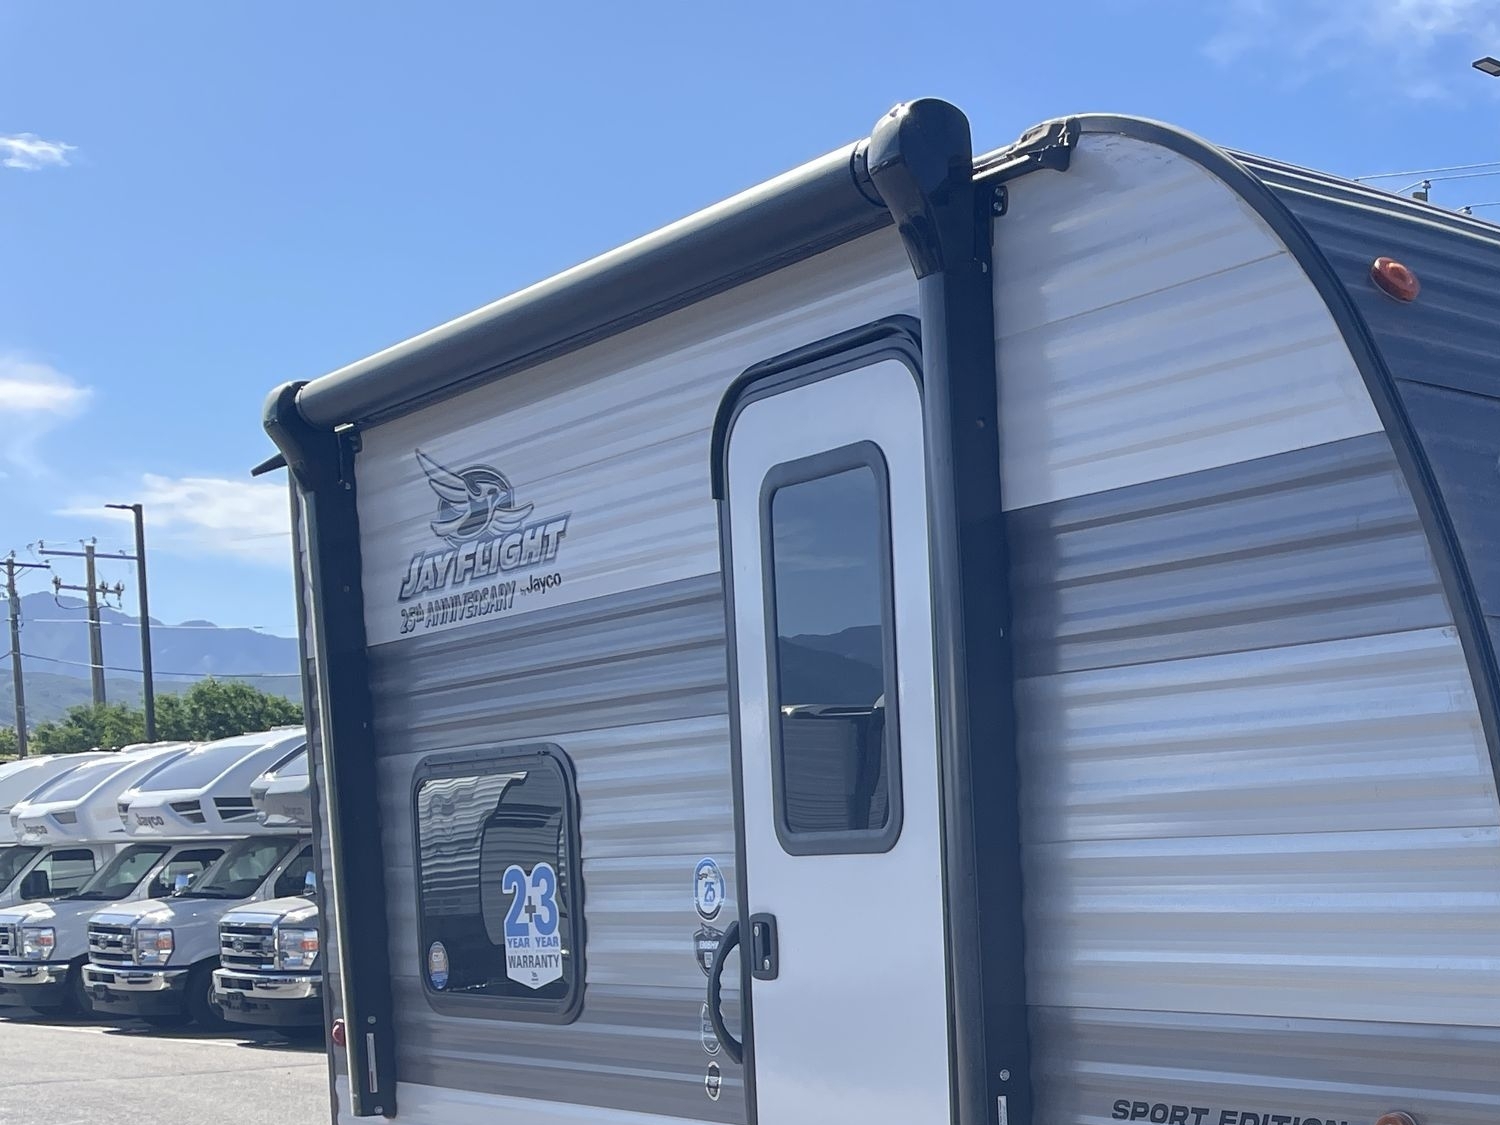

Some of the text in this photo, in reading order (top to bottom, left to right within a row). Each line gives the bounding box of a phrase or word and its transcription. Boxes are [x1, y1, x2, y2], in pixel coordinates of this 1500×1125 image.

[425, 580, 516, 628] ANNIVERSARY
[527, 573, 562, 594] Jayco
[136, 812, 165, 827] Jayco
[23, 822, 48, 835] Jayco
[507, 936, 559, 948] YEAR YEAR
[508, 954, 560, 969] WARRANTY
